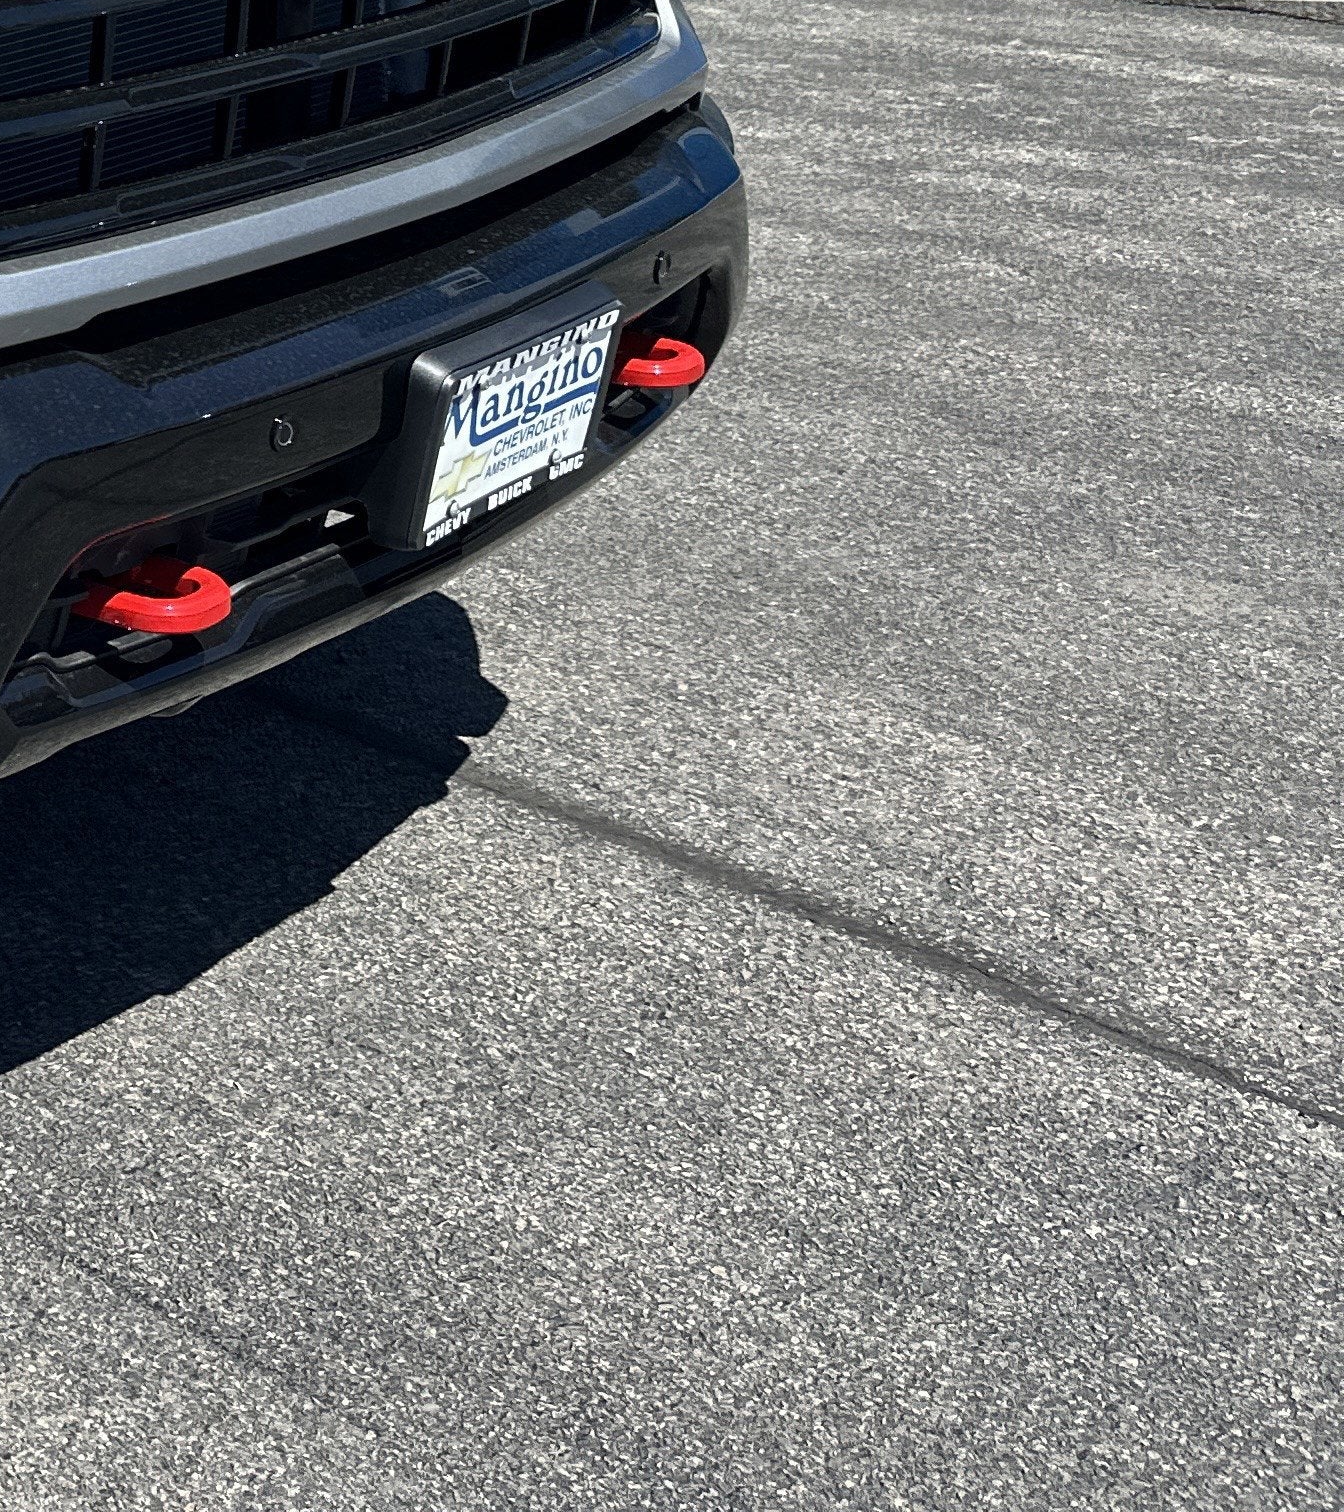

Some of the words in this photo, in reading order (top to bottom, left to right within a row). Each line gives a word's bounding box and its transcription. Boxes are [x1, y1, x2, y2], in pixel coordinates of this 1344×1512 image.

[443, 346, 604, 447] Mangino
[457, 309, 621, 397] MANGINO
[425, 506, 471, 548] CHEVY
[487, 475, 533, 512] BUICK
[548, 453, 585, 481] GMC
